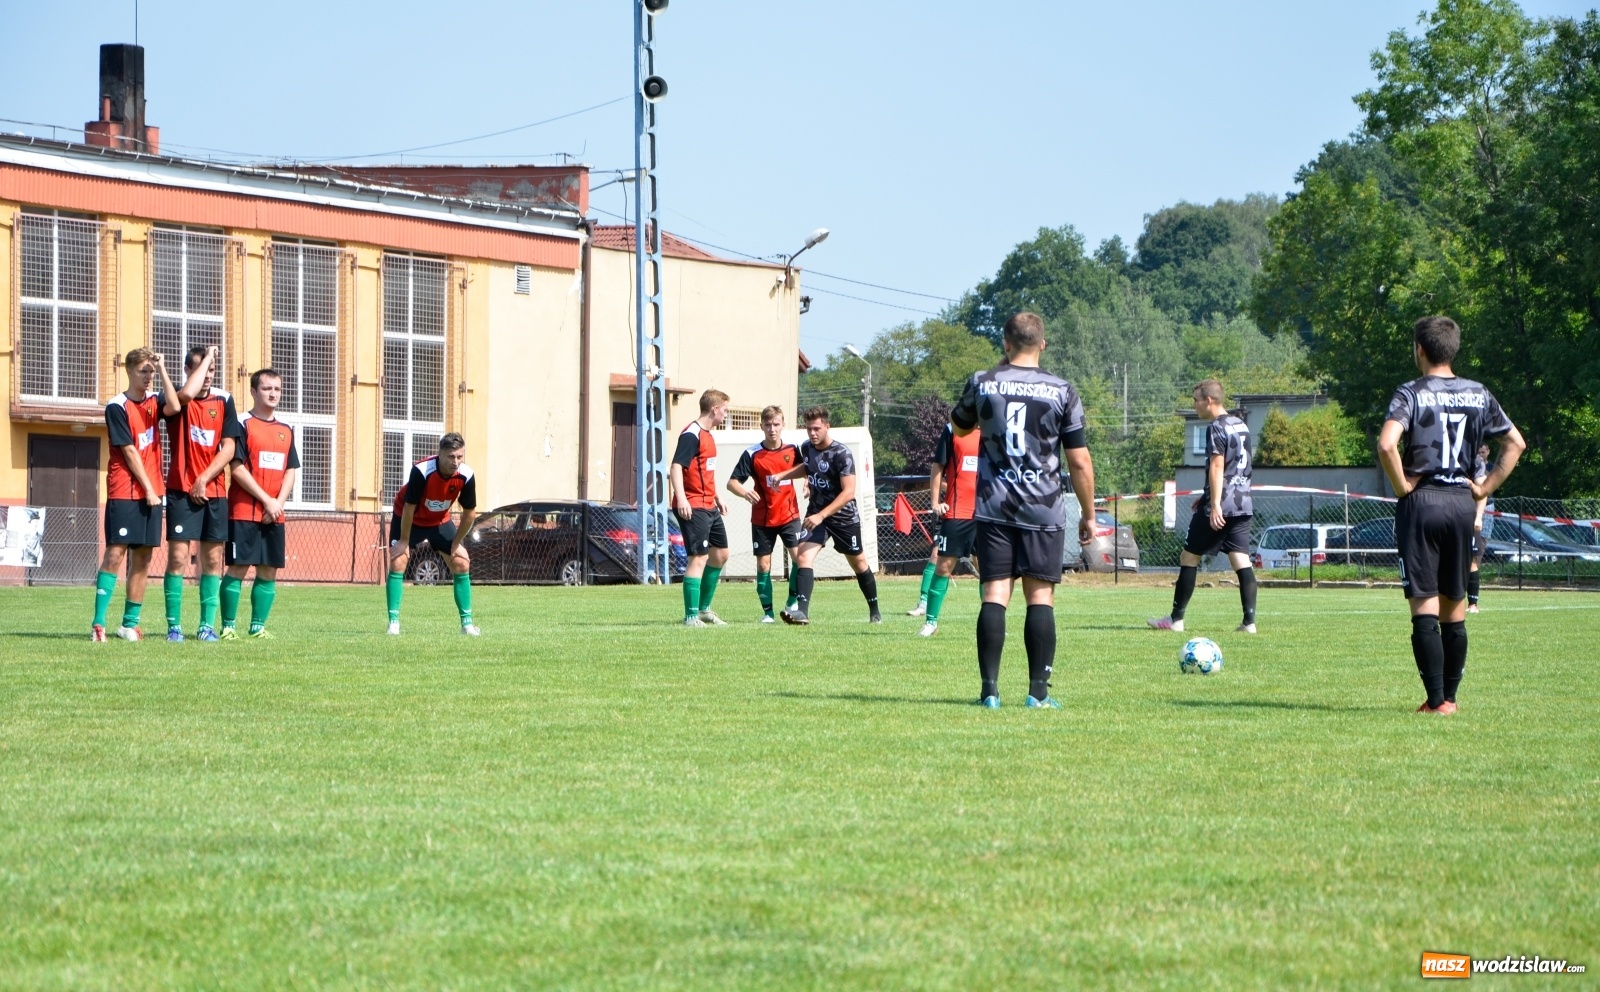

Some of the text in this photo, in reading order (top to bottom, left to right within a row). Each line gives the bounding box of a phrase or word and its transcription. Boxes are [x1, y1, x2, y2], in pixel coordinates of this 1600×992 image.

[999, 381, 1060, 401] OWSISZCZE
[1006, 401, 1027, 457] 8
[1439, 413, 1468, 469] 17
[938, 535, 948, 552] 21
